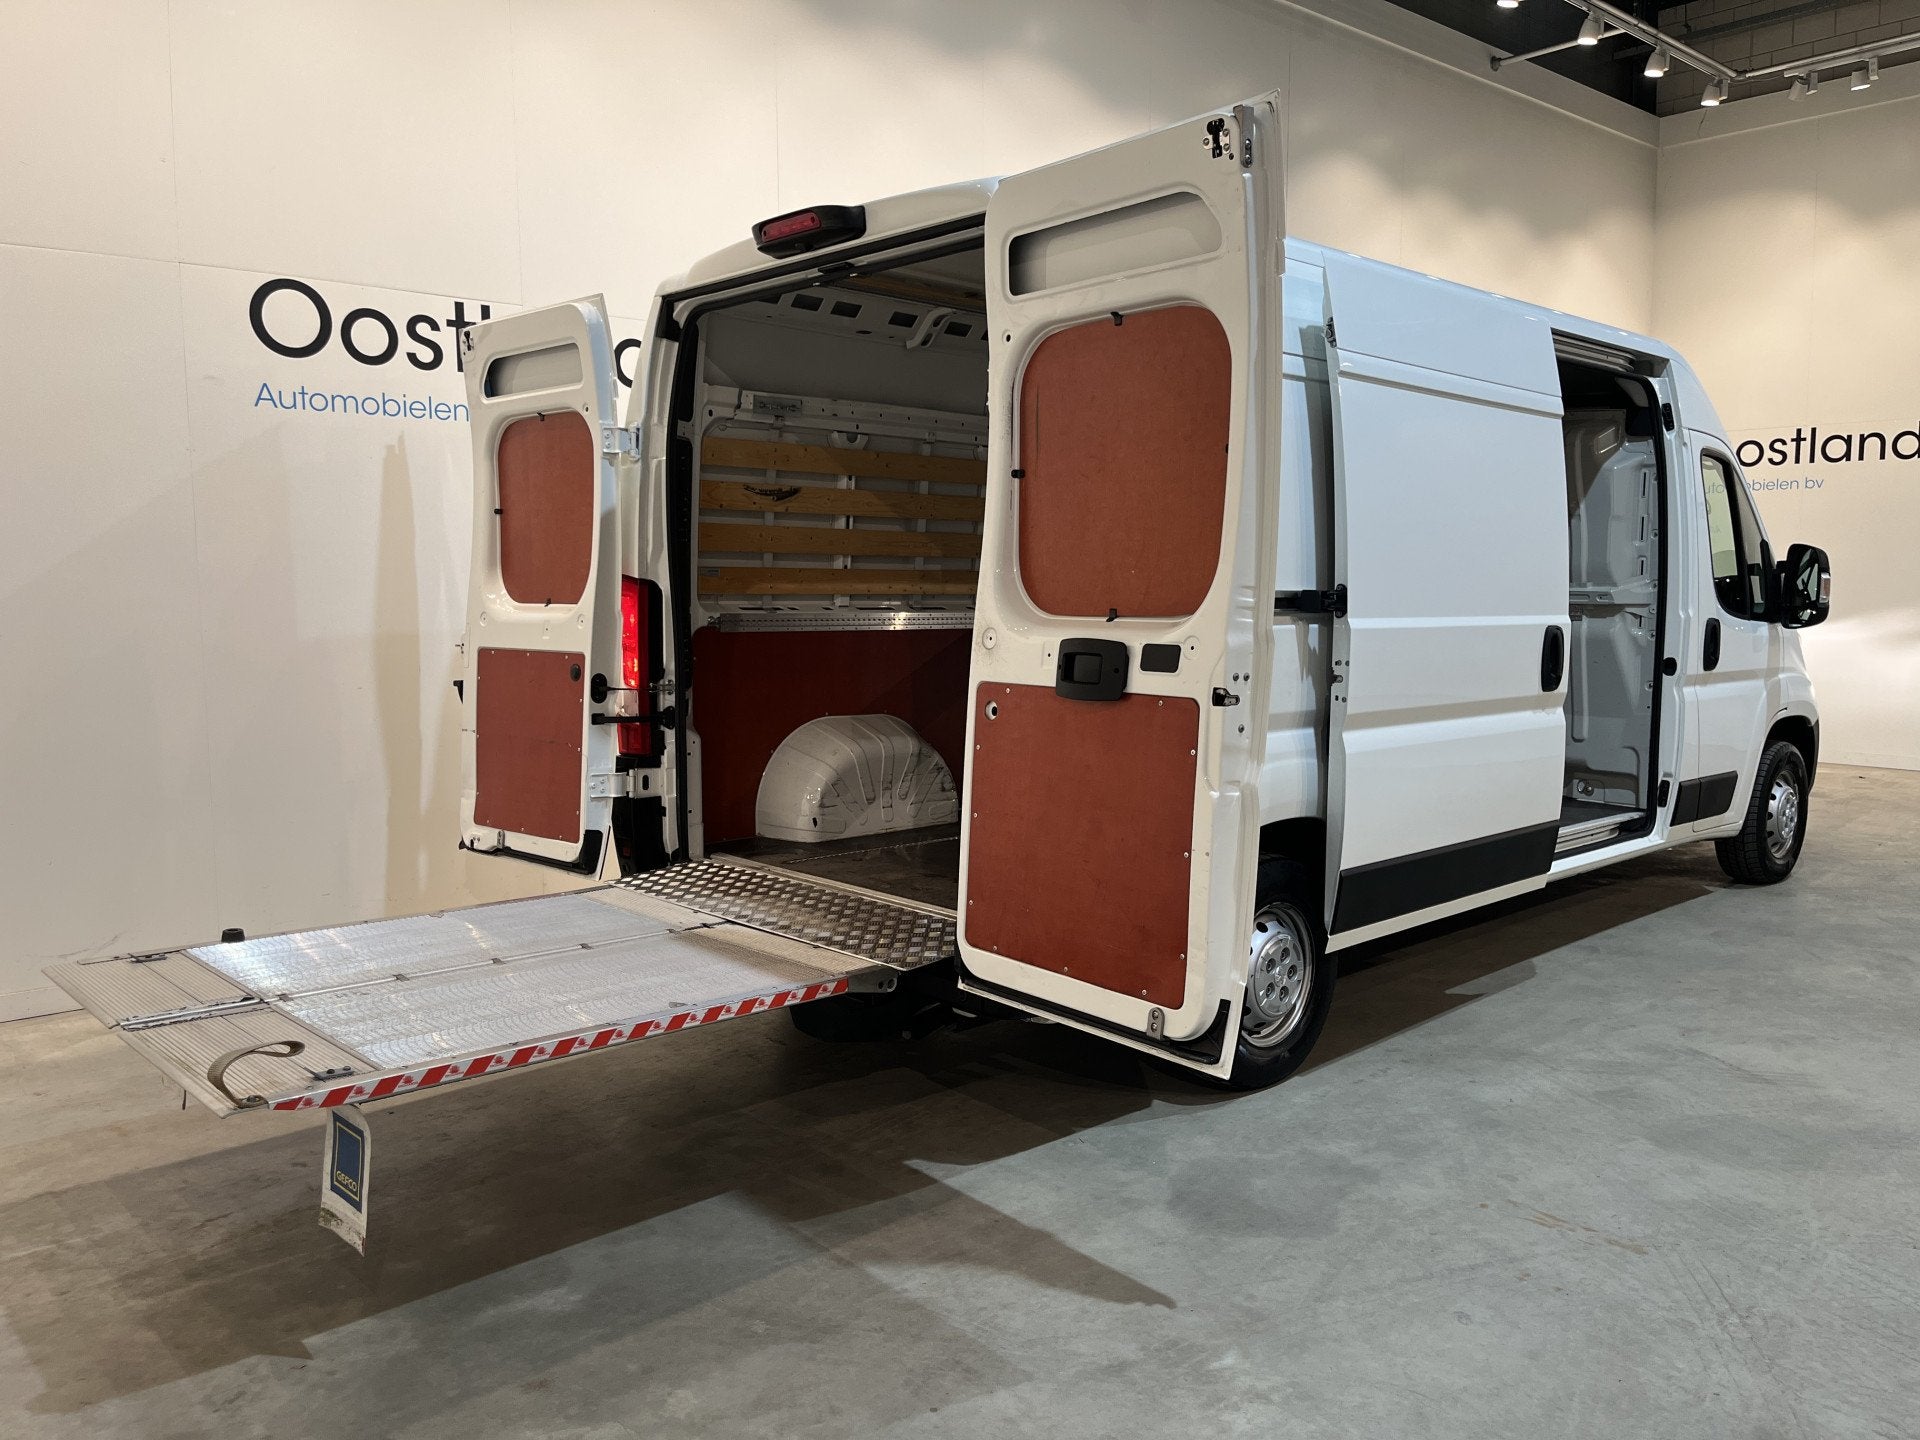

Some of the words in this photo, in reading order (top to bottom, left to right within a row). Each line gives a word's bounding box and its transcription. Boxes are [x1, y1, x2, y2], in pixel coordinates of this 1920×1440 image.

[254, 382, 470, 422] Automobielen
[1736, 421, 1920, 467] ostland
[1805, 477, 1824, 489] bv
[336, 1170, 358, 1192] GEFCO
